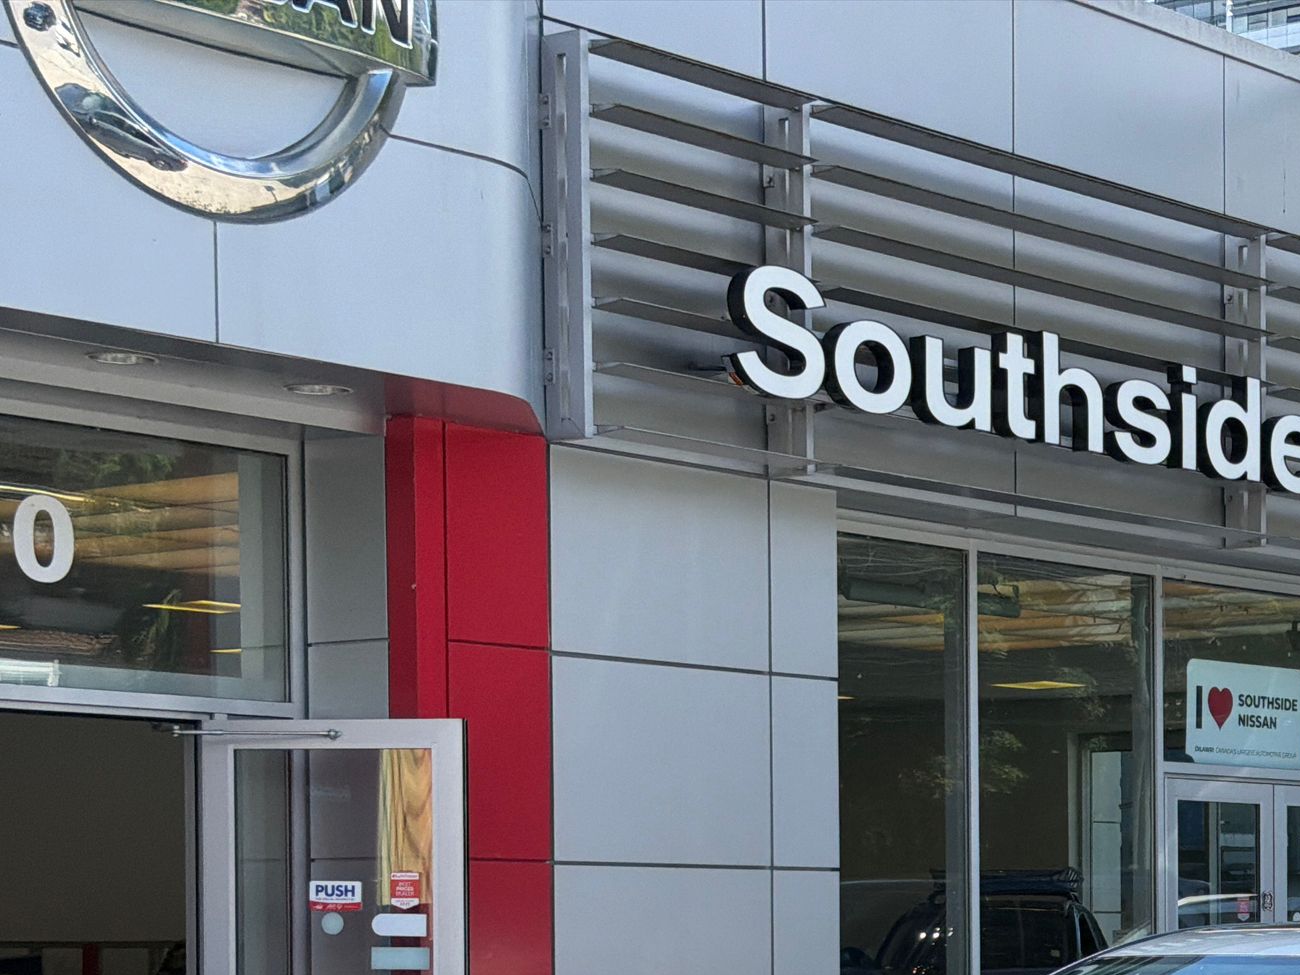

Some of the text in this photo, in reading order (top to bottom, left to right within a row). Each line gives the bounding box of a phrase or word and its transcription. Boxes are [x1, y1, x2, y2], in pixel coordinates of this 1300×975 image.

[13, 494, 75, 583] 0
[1196, 685, 1203, 729] I
[1238, 694, 1298, 712] SOUTHSIDE
[1238, 714, 1277, 730] NISSAN
[315, 884, 356, 898] PUSH
